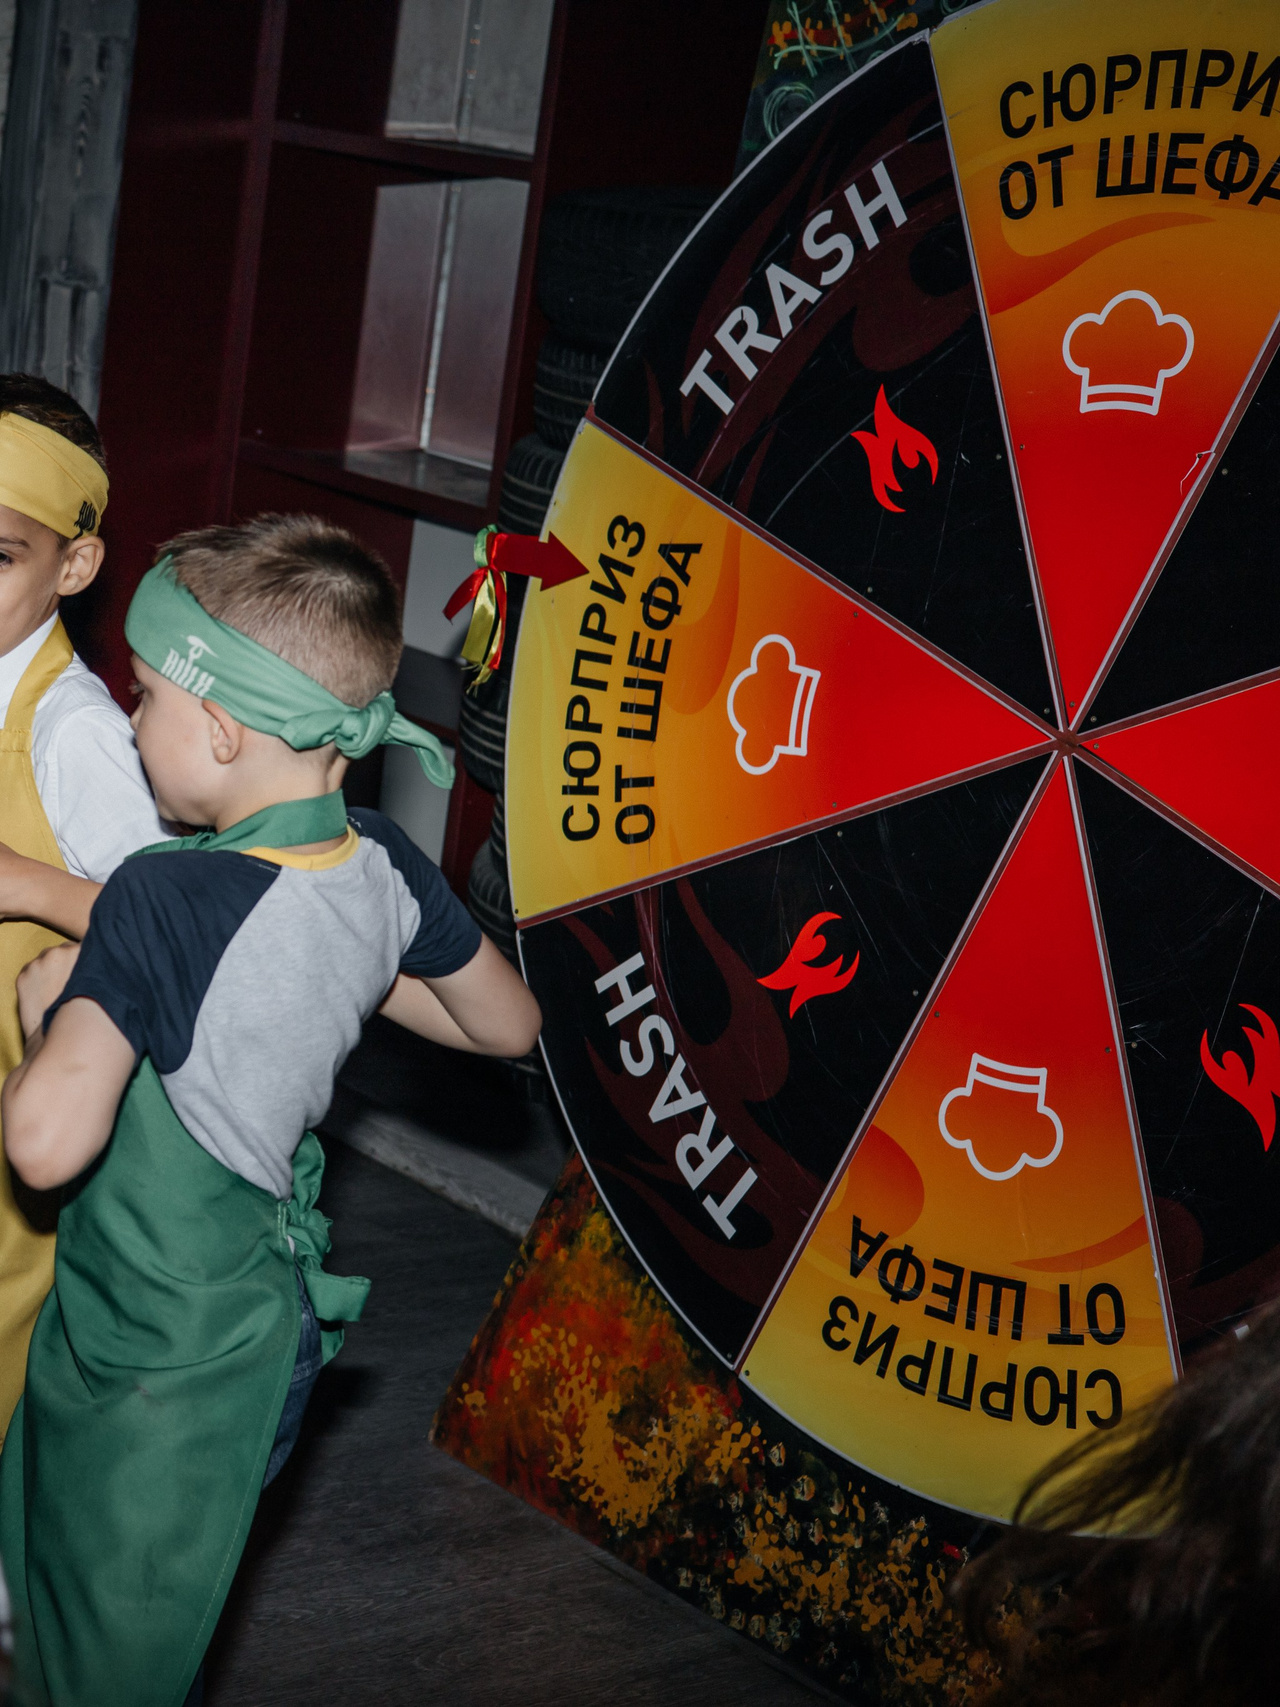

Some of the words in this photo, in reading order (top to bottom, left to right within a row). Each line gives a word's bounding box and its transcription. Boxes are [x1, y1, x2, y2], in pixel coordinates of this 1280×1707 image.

[999, 48, 1280, 138] СЮРПРИ
[999, 145, 1074, 220] ОТ
[679, 160, 908, 416] TRASH
[561, 515, 646, 842] СЮРПРИЗ
[617, 543, 703, 742] ШЕФА
[614, 764, 656, 845] ОТ
[594, 951, 758, 1240] TRASH
[850, 1215, 1027, 1341] ШЕФА
[1047, 1282, 1126, 1346] ОТ
[821, 1295, 1123, 1430] СЮРПРИЗ
